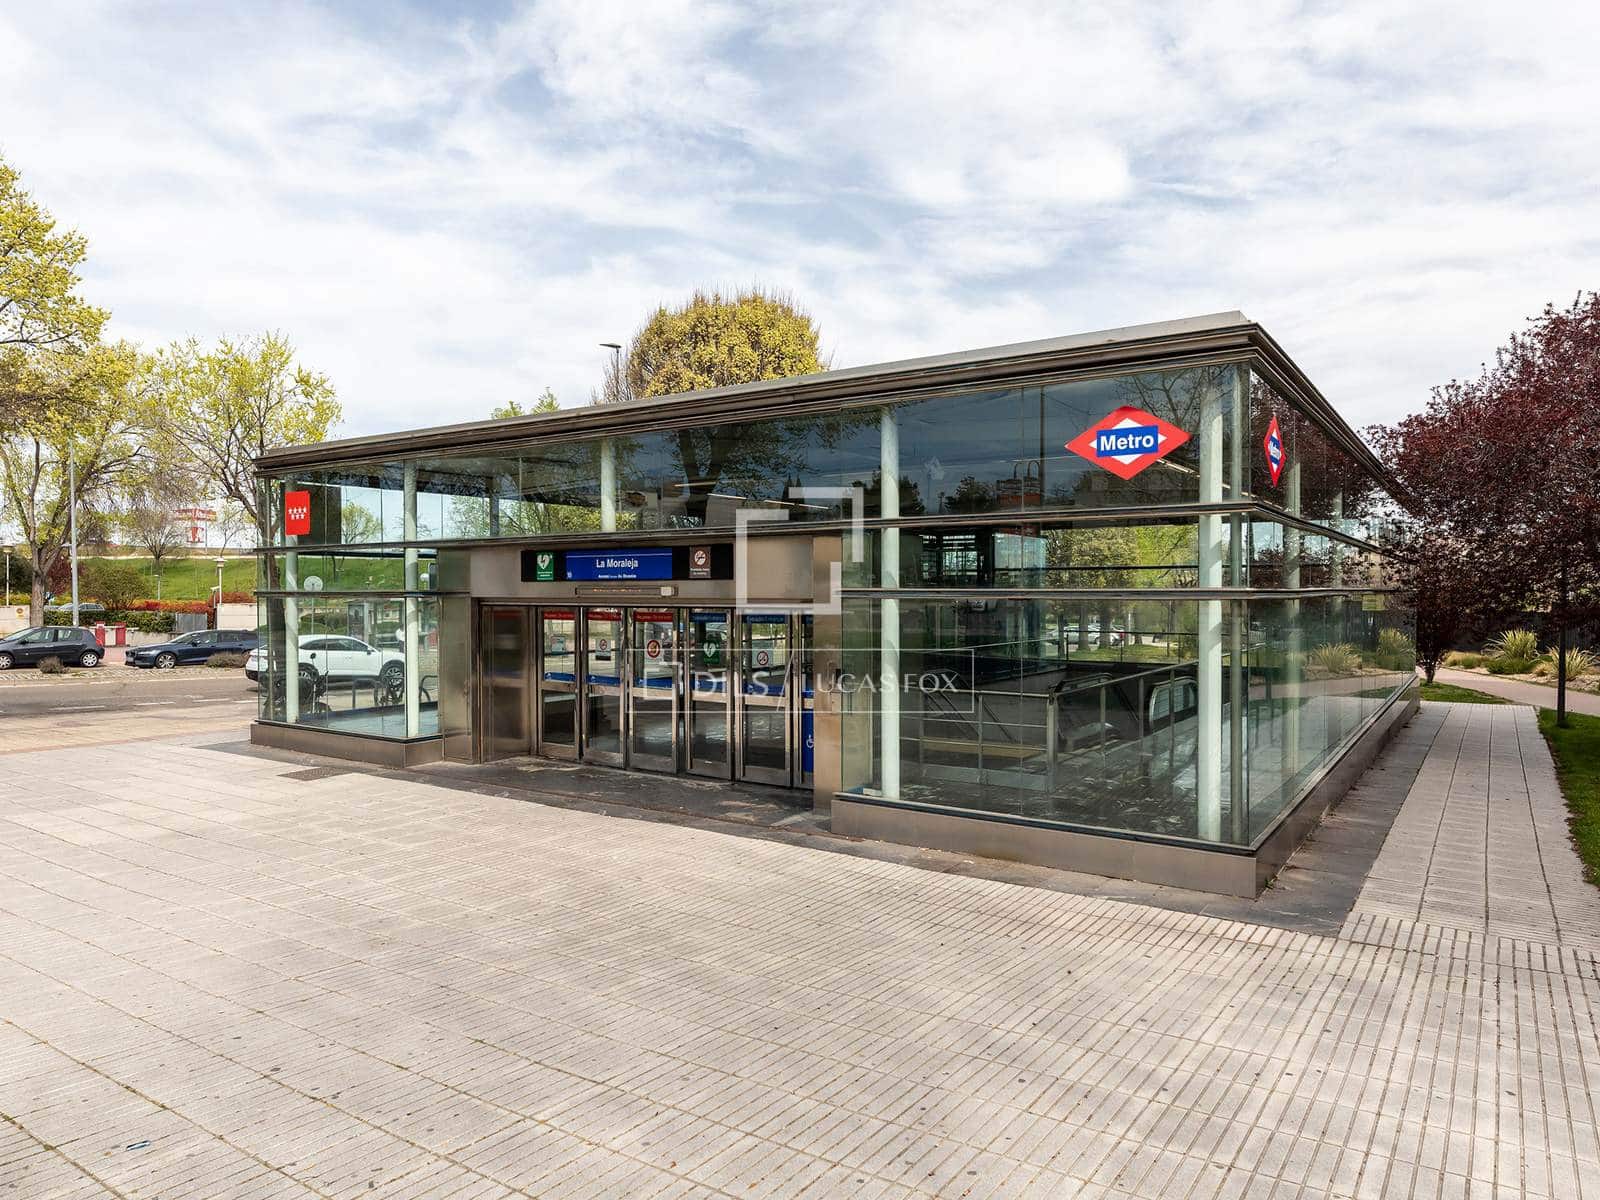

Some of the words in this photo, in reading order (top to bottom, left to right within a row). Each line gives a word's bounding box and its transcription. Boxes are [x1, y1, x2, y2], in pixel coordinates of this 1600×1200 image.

[1100, 434, 1154, 451] Metro
[596, 559, 605, 568] La
[607, 558, 639, 570] Moraleja
